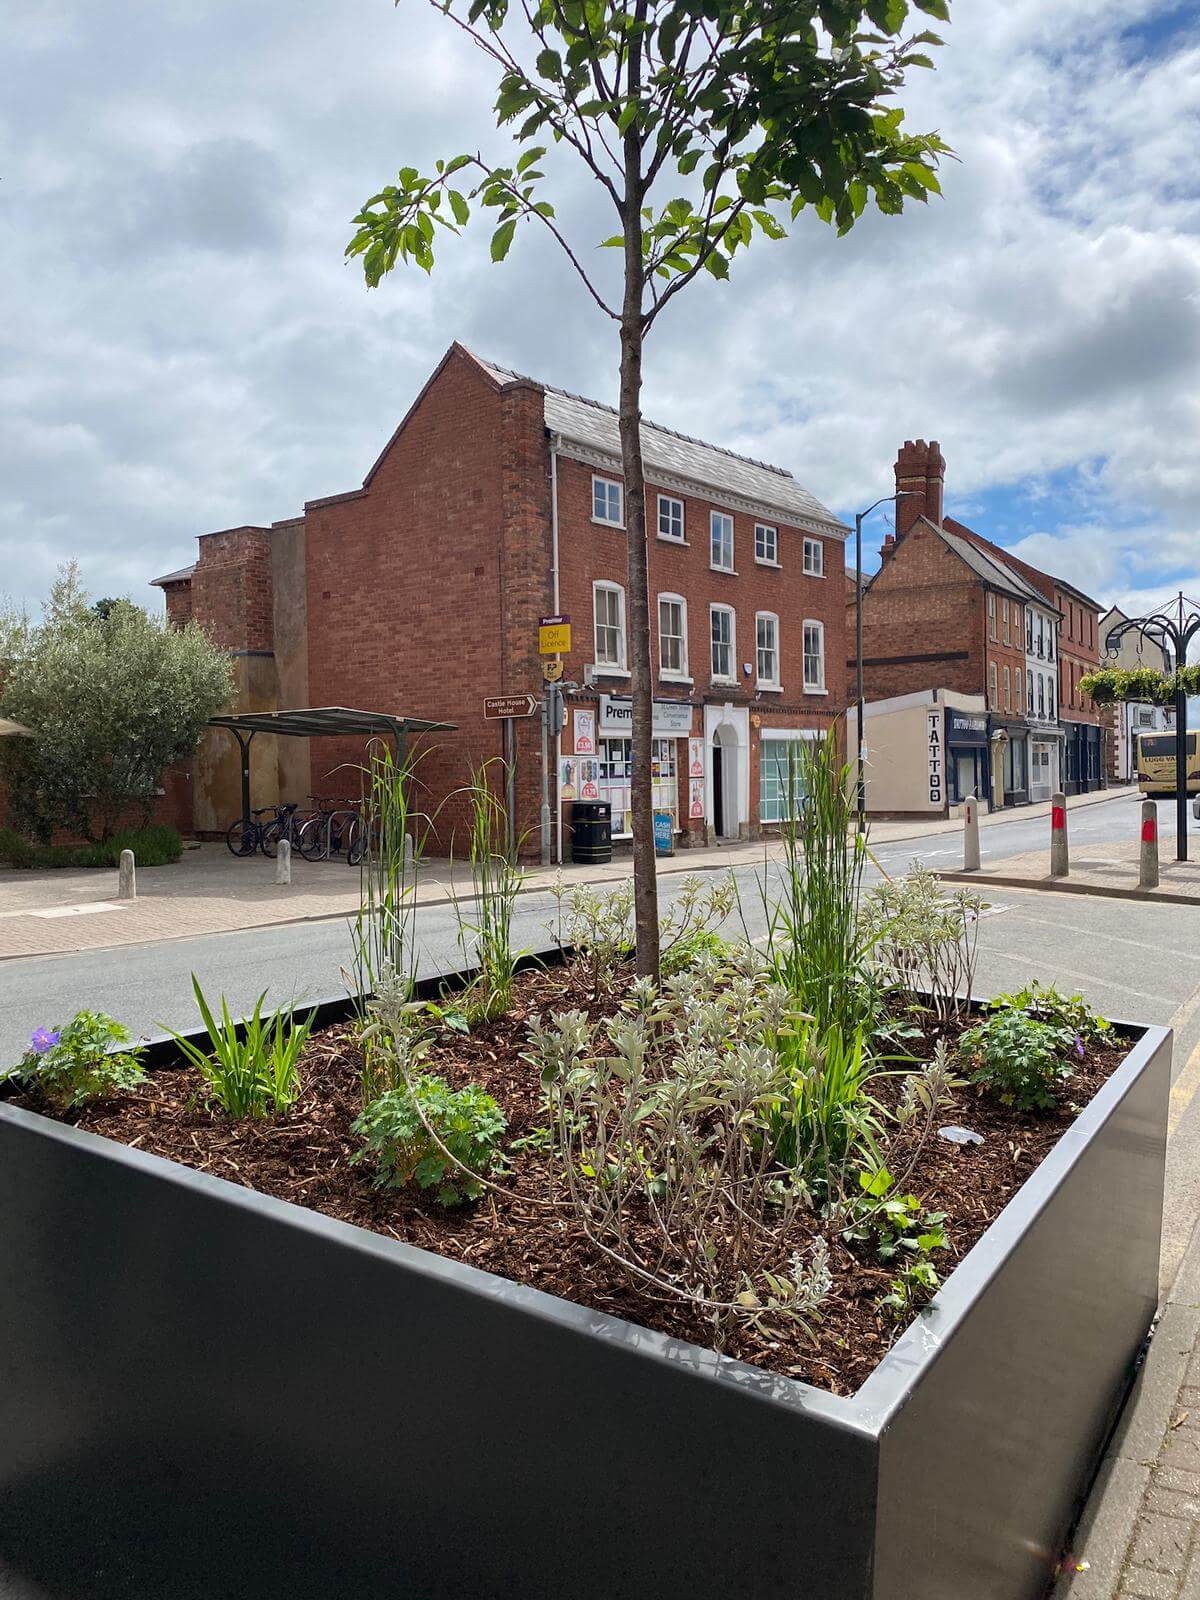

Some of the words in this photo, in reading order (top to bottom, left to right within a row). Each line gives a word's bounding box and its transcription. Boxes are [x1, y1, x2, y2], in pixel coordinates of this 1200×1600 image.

[547, 630, 560, 639] Off
[541, 639, 566, 648] Licence
[487, 700, 506, 708] Castle
[498, 707, 514, 715] Hotel
[606, 705, 633, 719] Prem
[928, 715, 941, 802] TATTOO
